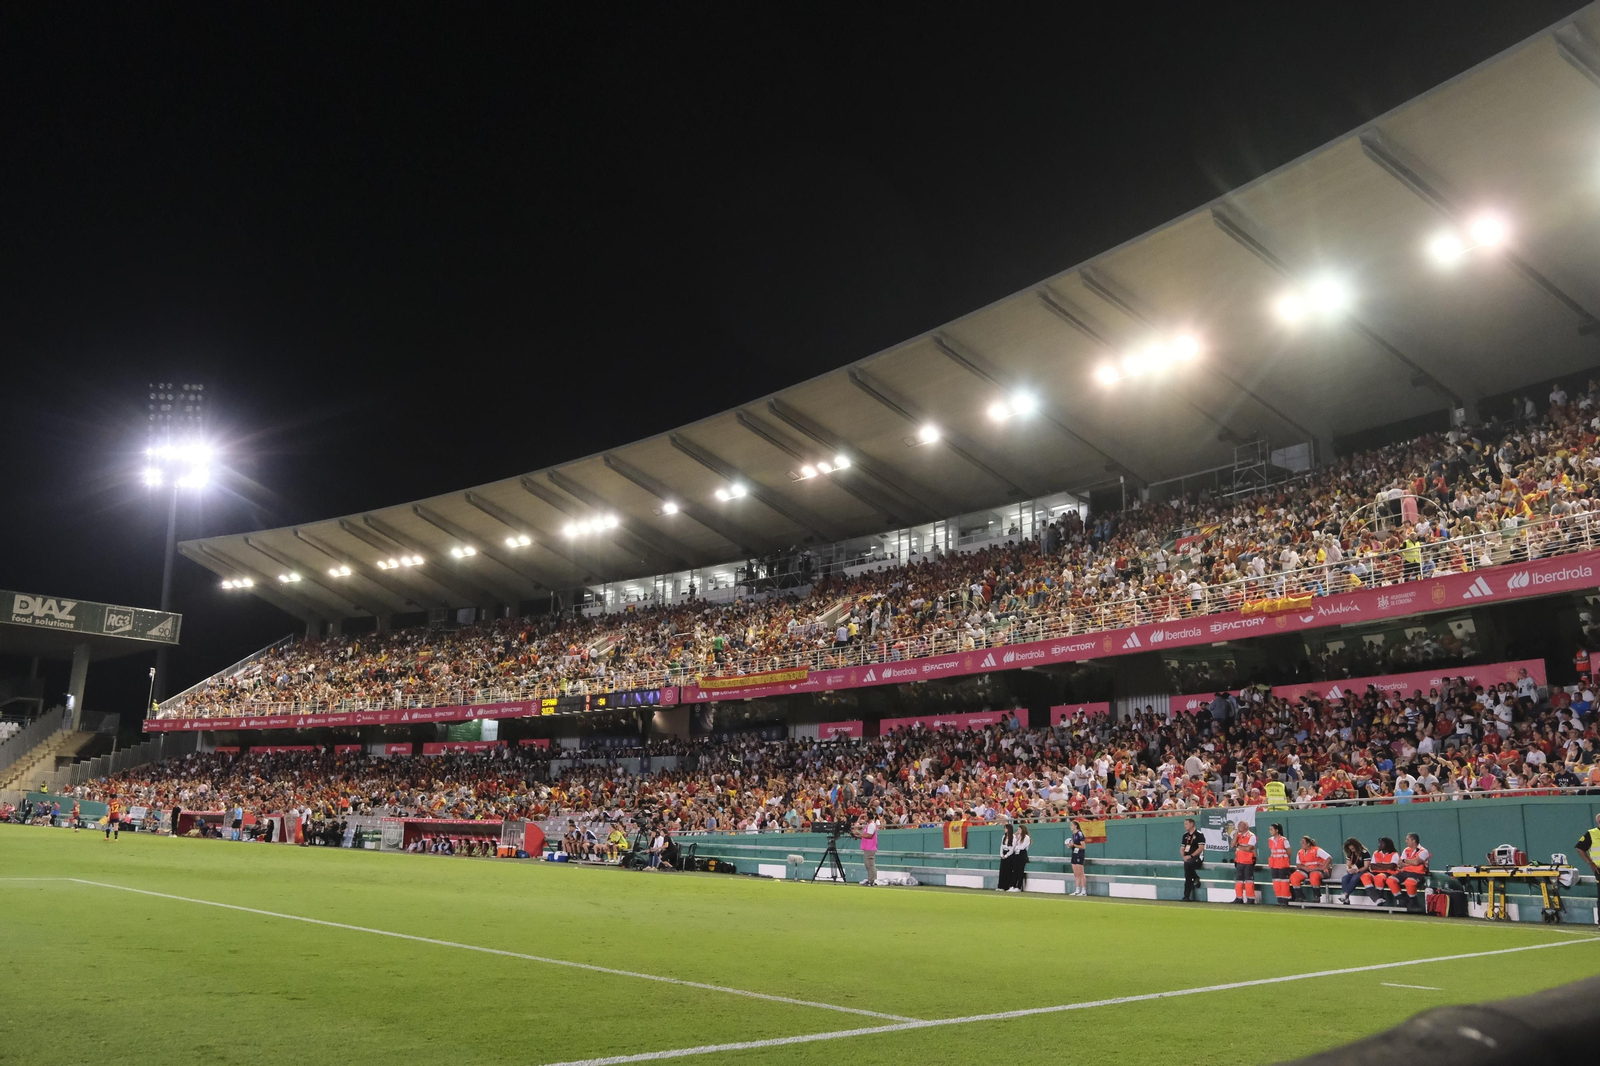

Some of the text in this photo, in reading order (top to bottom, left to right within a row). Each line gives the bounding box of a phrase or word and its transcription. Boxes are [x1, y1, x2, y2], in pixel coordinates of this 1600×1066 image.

[1532, 566, 1592, 585] Iberdrola
[12, 594, 78, 621] DIAZ
[11, 613, 74, 629] food solutions
[107, 614, 130, 627] RG3
[158, 627, 171, 637] 90
[1165, 628, 1202, 641] Iberdrola
[1016, 650, 1045, 661] Iberdrola
[892, 667, 917, 677] Iberdrola
[1378, 681, 1408, 691] Iberdrola
